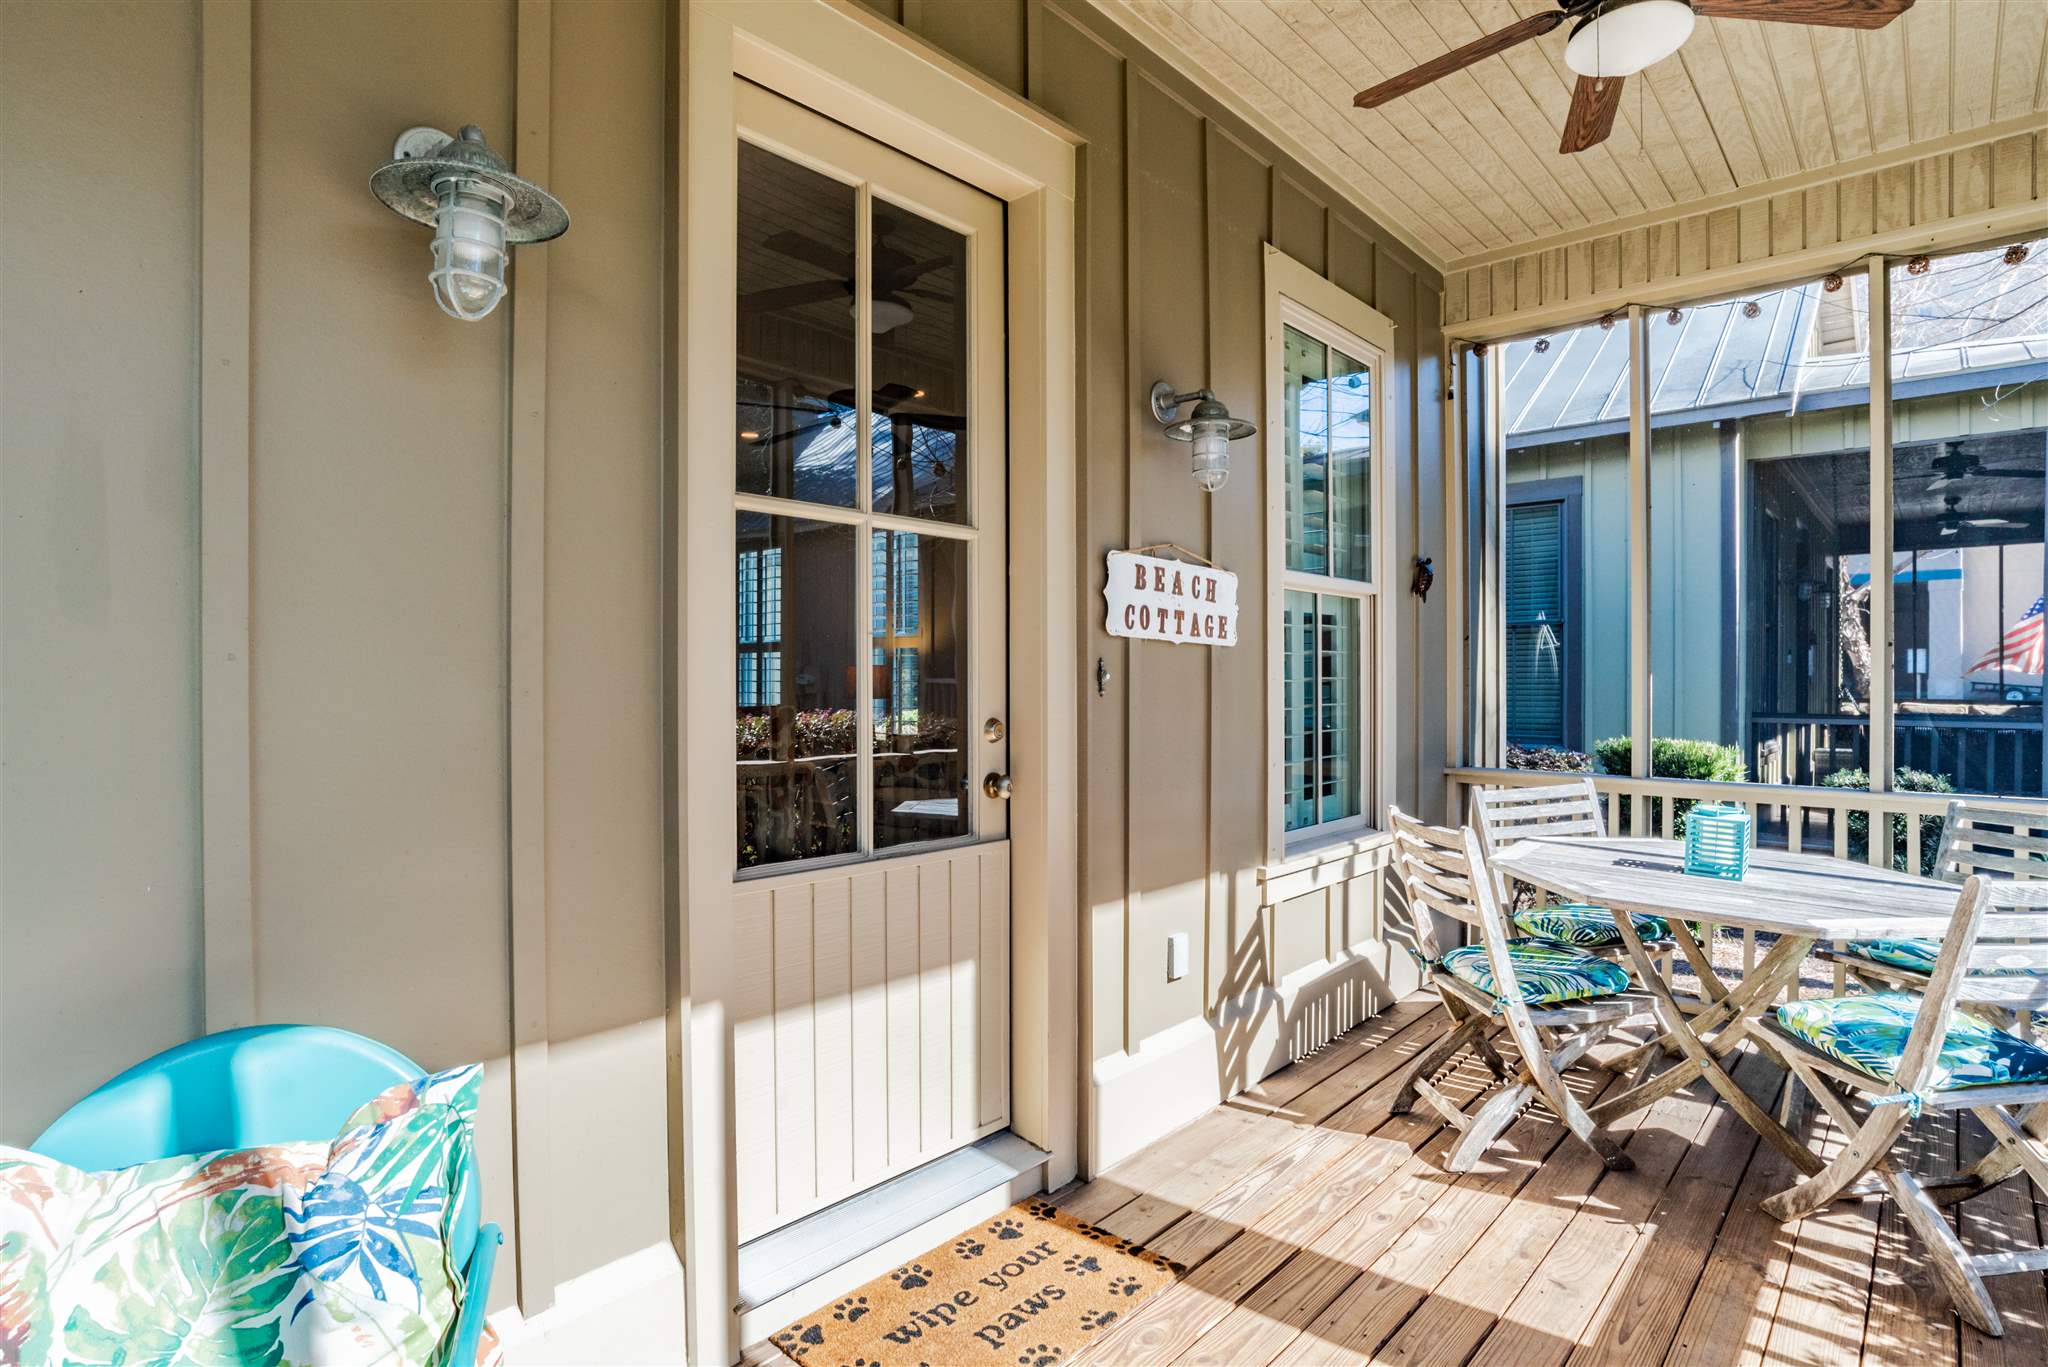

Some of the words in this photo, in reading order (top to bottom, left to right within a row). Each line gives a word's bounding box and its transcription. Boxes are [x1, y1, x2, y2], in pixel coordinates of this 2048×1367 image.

[1134, 563, 1217, 603] BEACH
[1124, 604, 1228, 640] COTTAGE
[883, 1288, 980, 1346] wipe
[979, 1240, 1059, 1292] your
[973, 1284, 1066, 1350] paws
